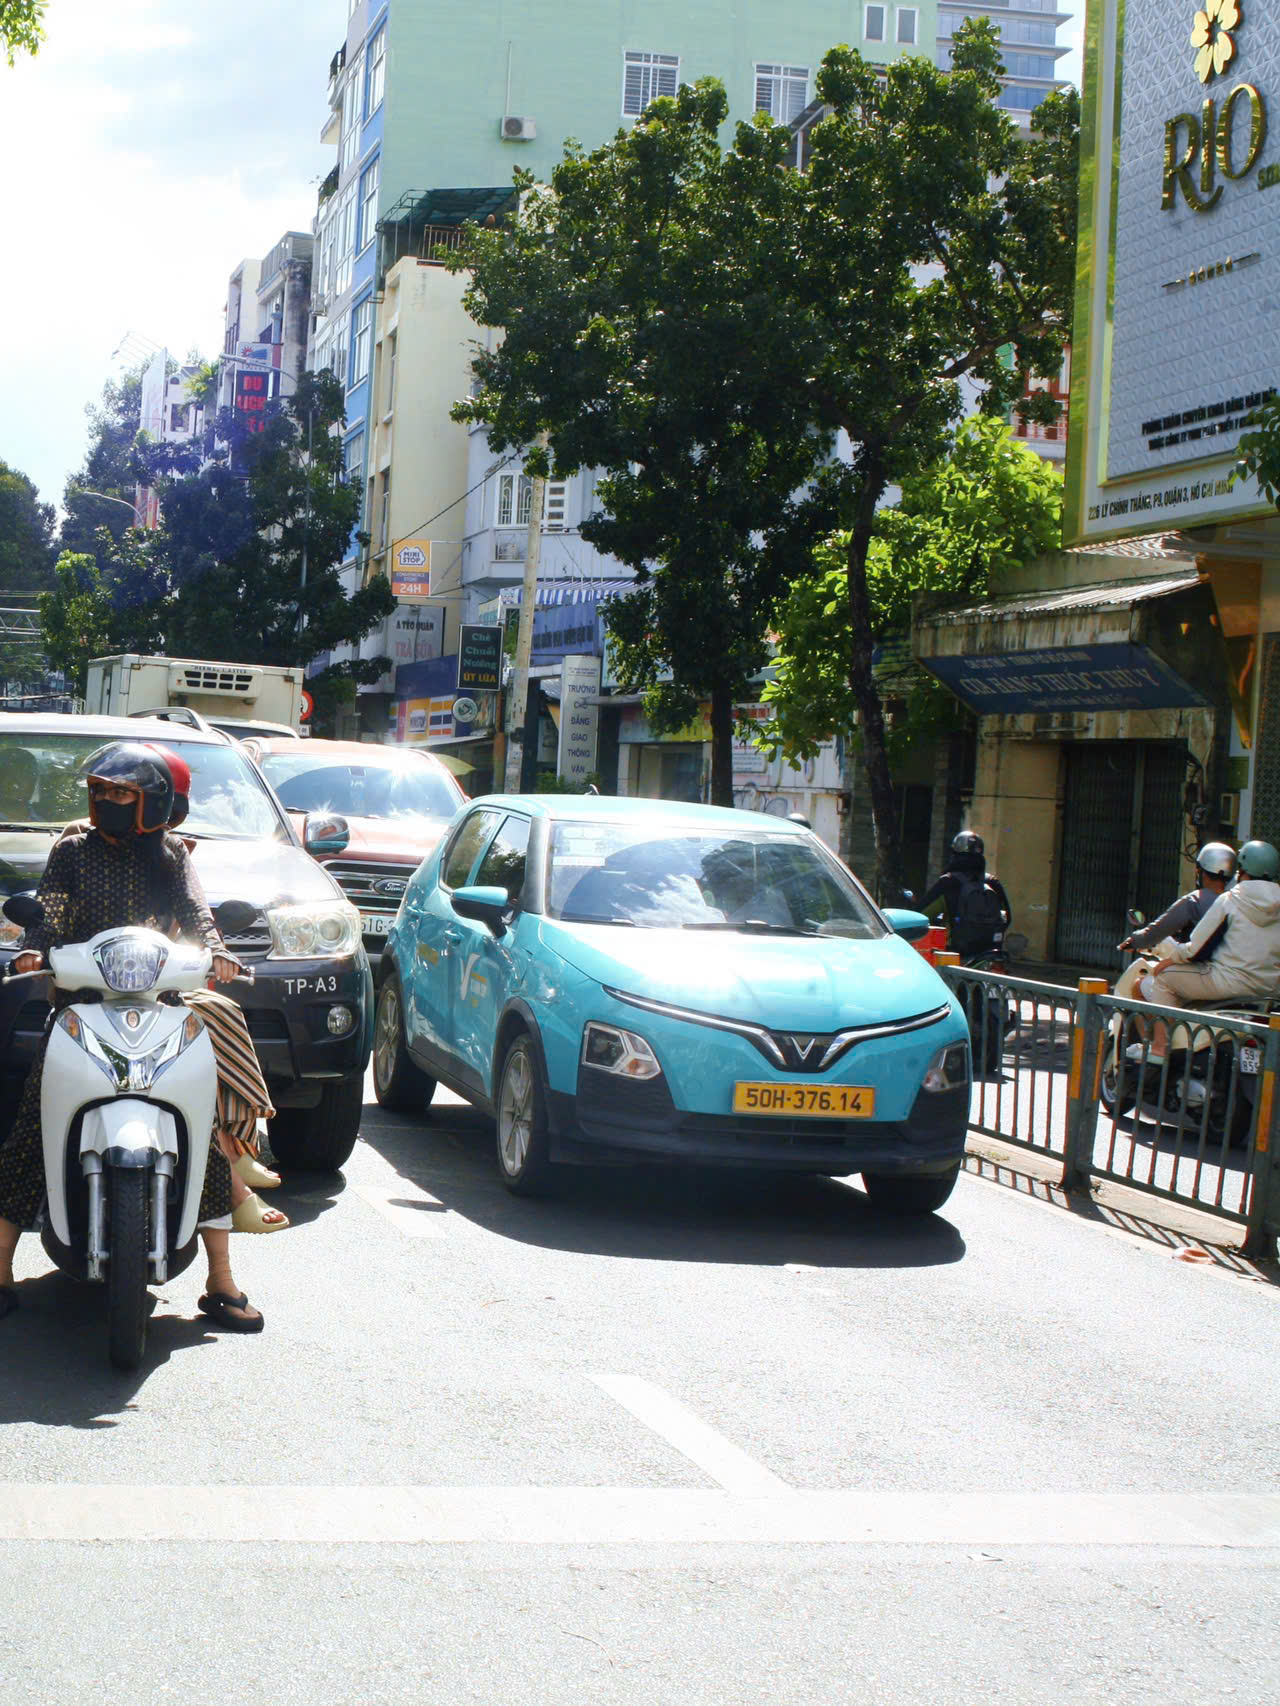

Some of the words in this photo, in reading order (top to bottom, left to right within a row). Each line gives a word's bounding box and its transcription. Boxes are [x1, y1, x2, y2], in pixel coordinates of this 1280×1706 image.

[1161, 83, 1267, 212] RIO
[399, 583, 421, 593] 24H
[571, 733, 587, 742] GIAO
[285, 976, 337, 995] TP-A3
[746, 1088, 862, 1112] 50H-376.14
